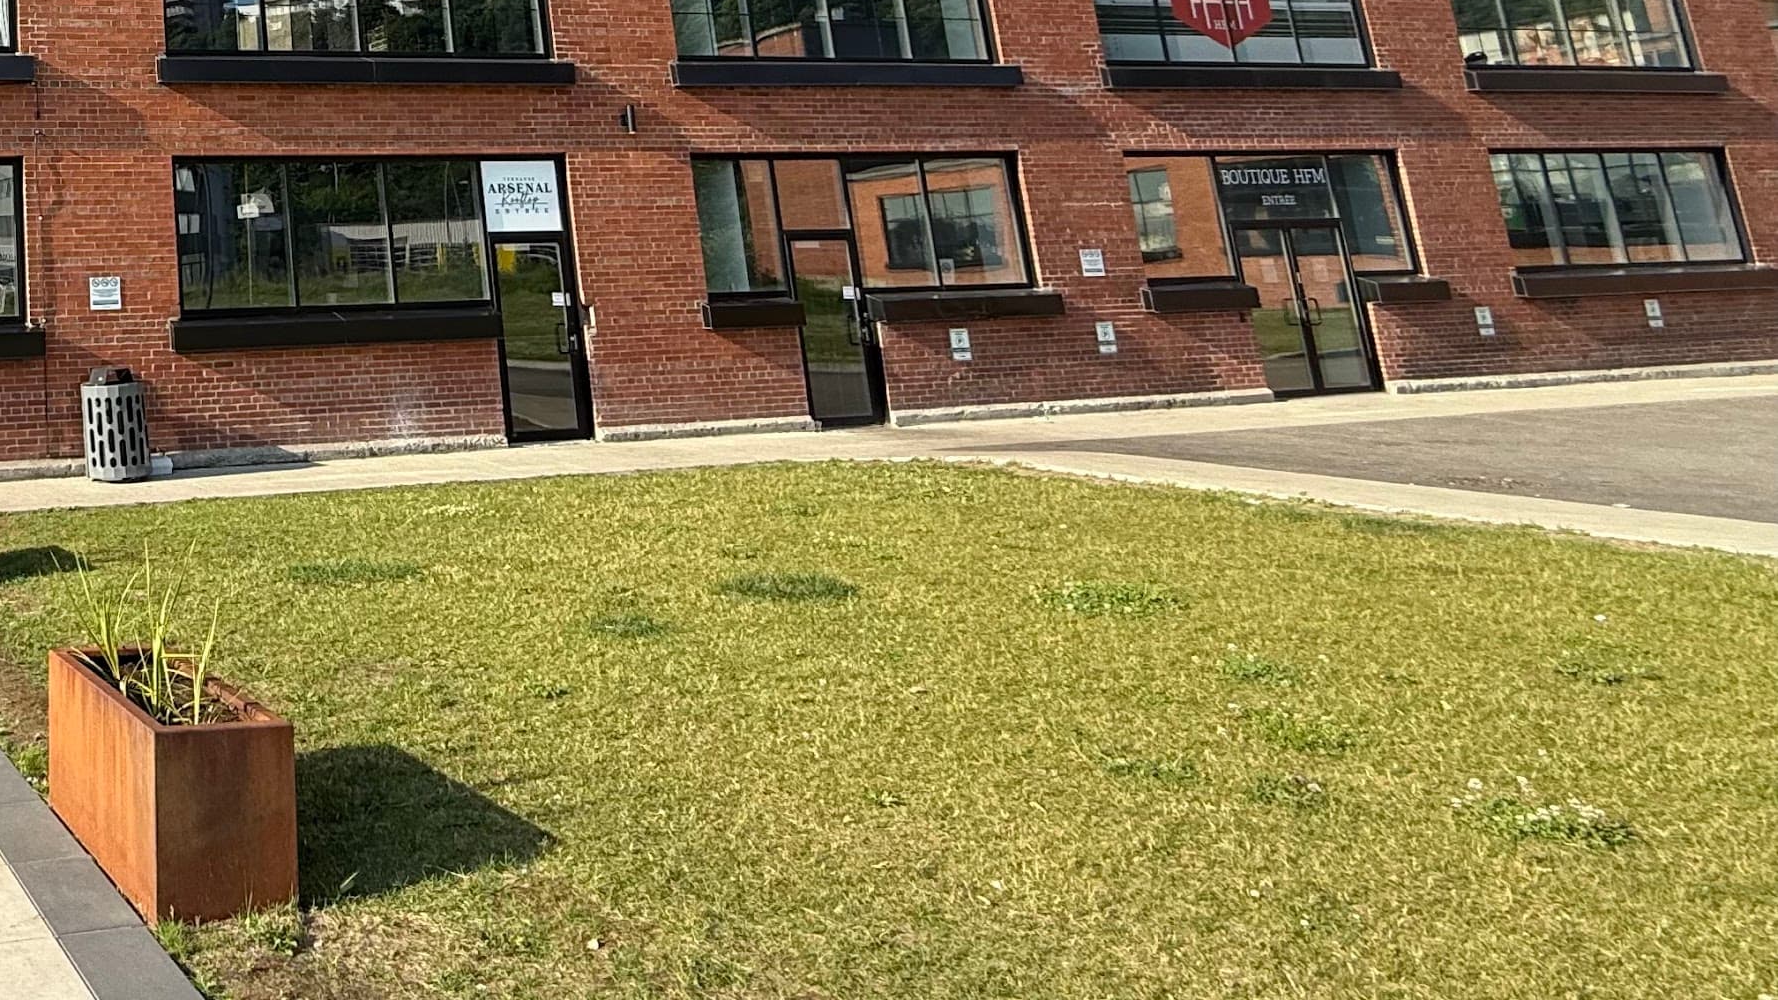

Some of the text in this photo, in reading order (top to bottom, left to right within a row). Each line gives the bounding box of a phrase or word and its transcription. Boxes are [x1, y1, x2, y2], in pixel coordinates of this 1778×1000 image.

[1220, 168, 1326, 185] BOUTIQUE HFM
[487, 182, 552, 194] ARSENAL
